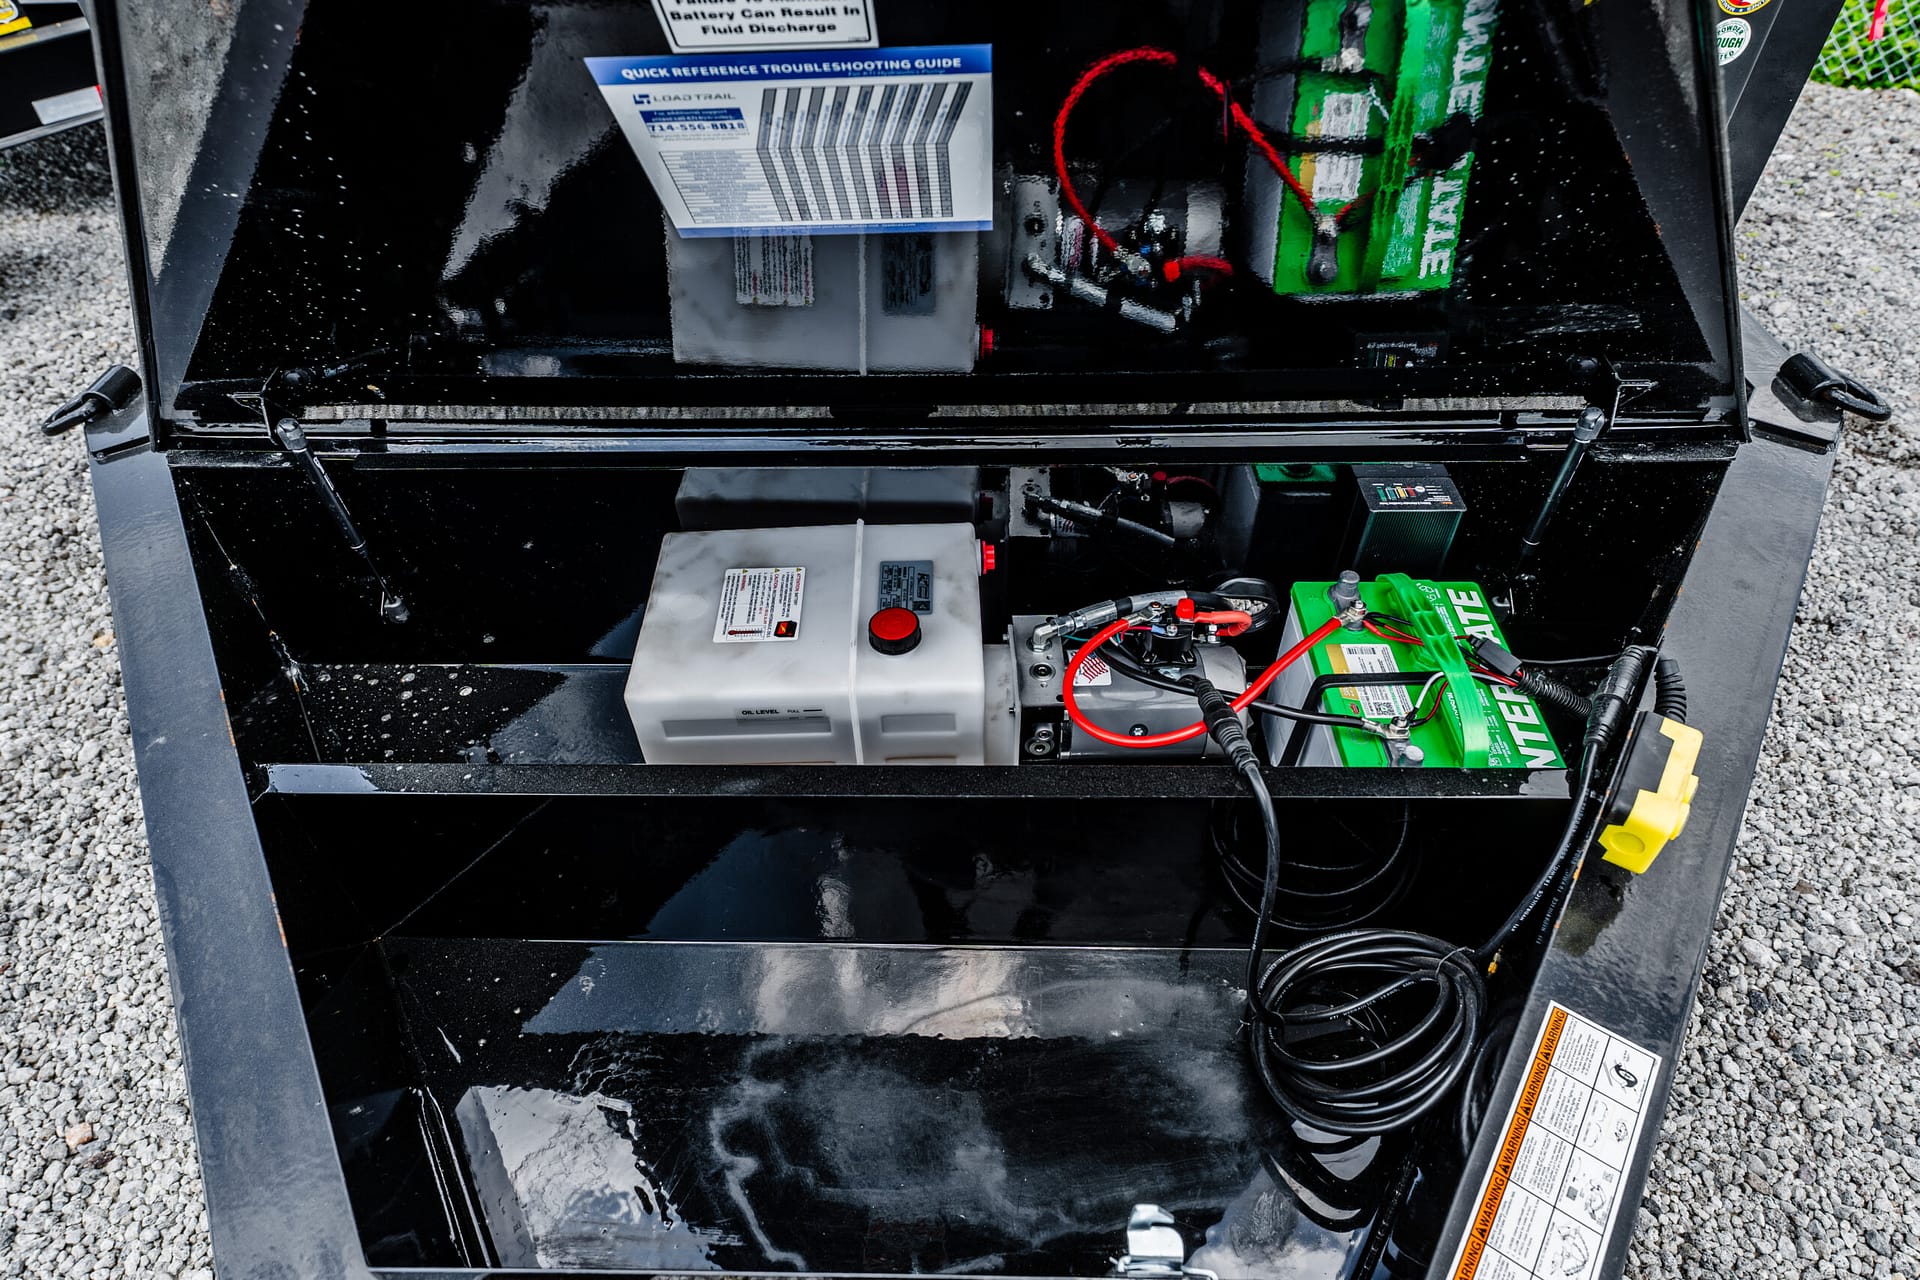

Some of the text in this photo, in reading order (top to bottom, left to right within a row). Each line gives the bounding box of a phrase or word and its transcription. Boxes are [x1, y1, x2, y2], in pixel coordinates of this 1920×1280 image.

[670, 6, 861, 21] Battery Can Result In
[701, 23, 837, 35] Fluid Discharge
[1717, 37, 1744, 48] OUGH
[621, 57, 962, 81] QUICK REFERENCE TROUBLESHOOTING GUIDE
[653, 93, 736, 103] LOAD TRAIL
[648, 123, 745, 132] 714-556-8818
[1545, 1011, 1565, 1051] WARNING
[1524, 1062, 1547, 1106] WARNING
[1504, 1117, 1527, 1164] WARNING
[1480, 1177, 1504, 1229] WARNING
